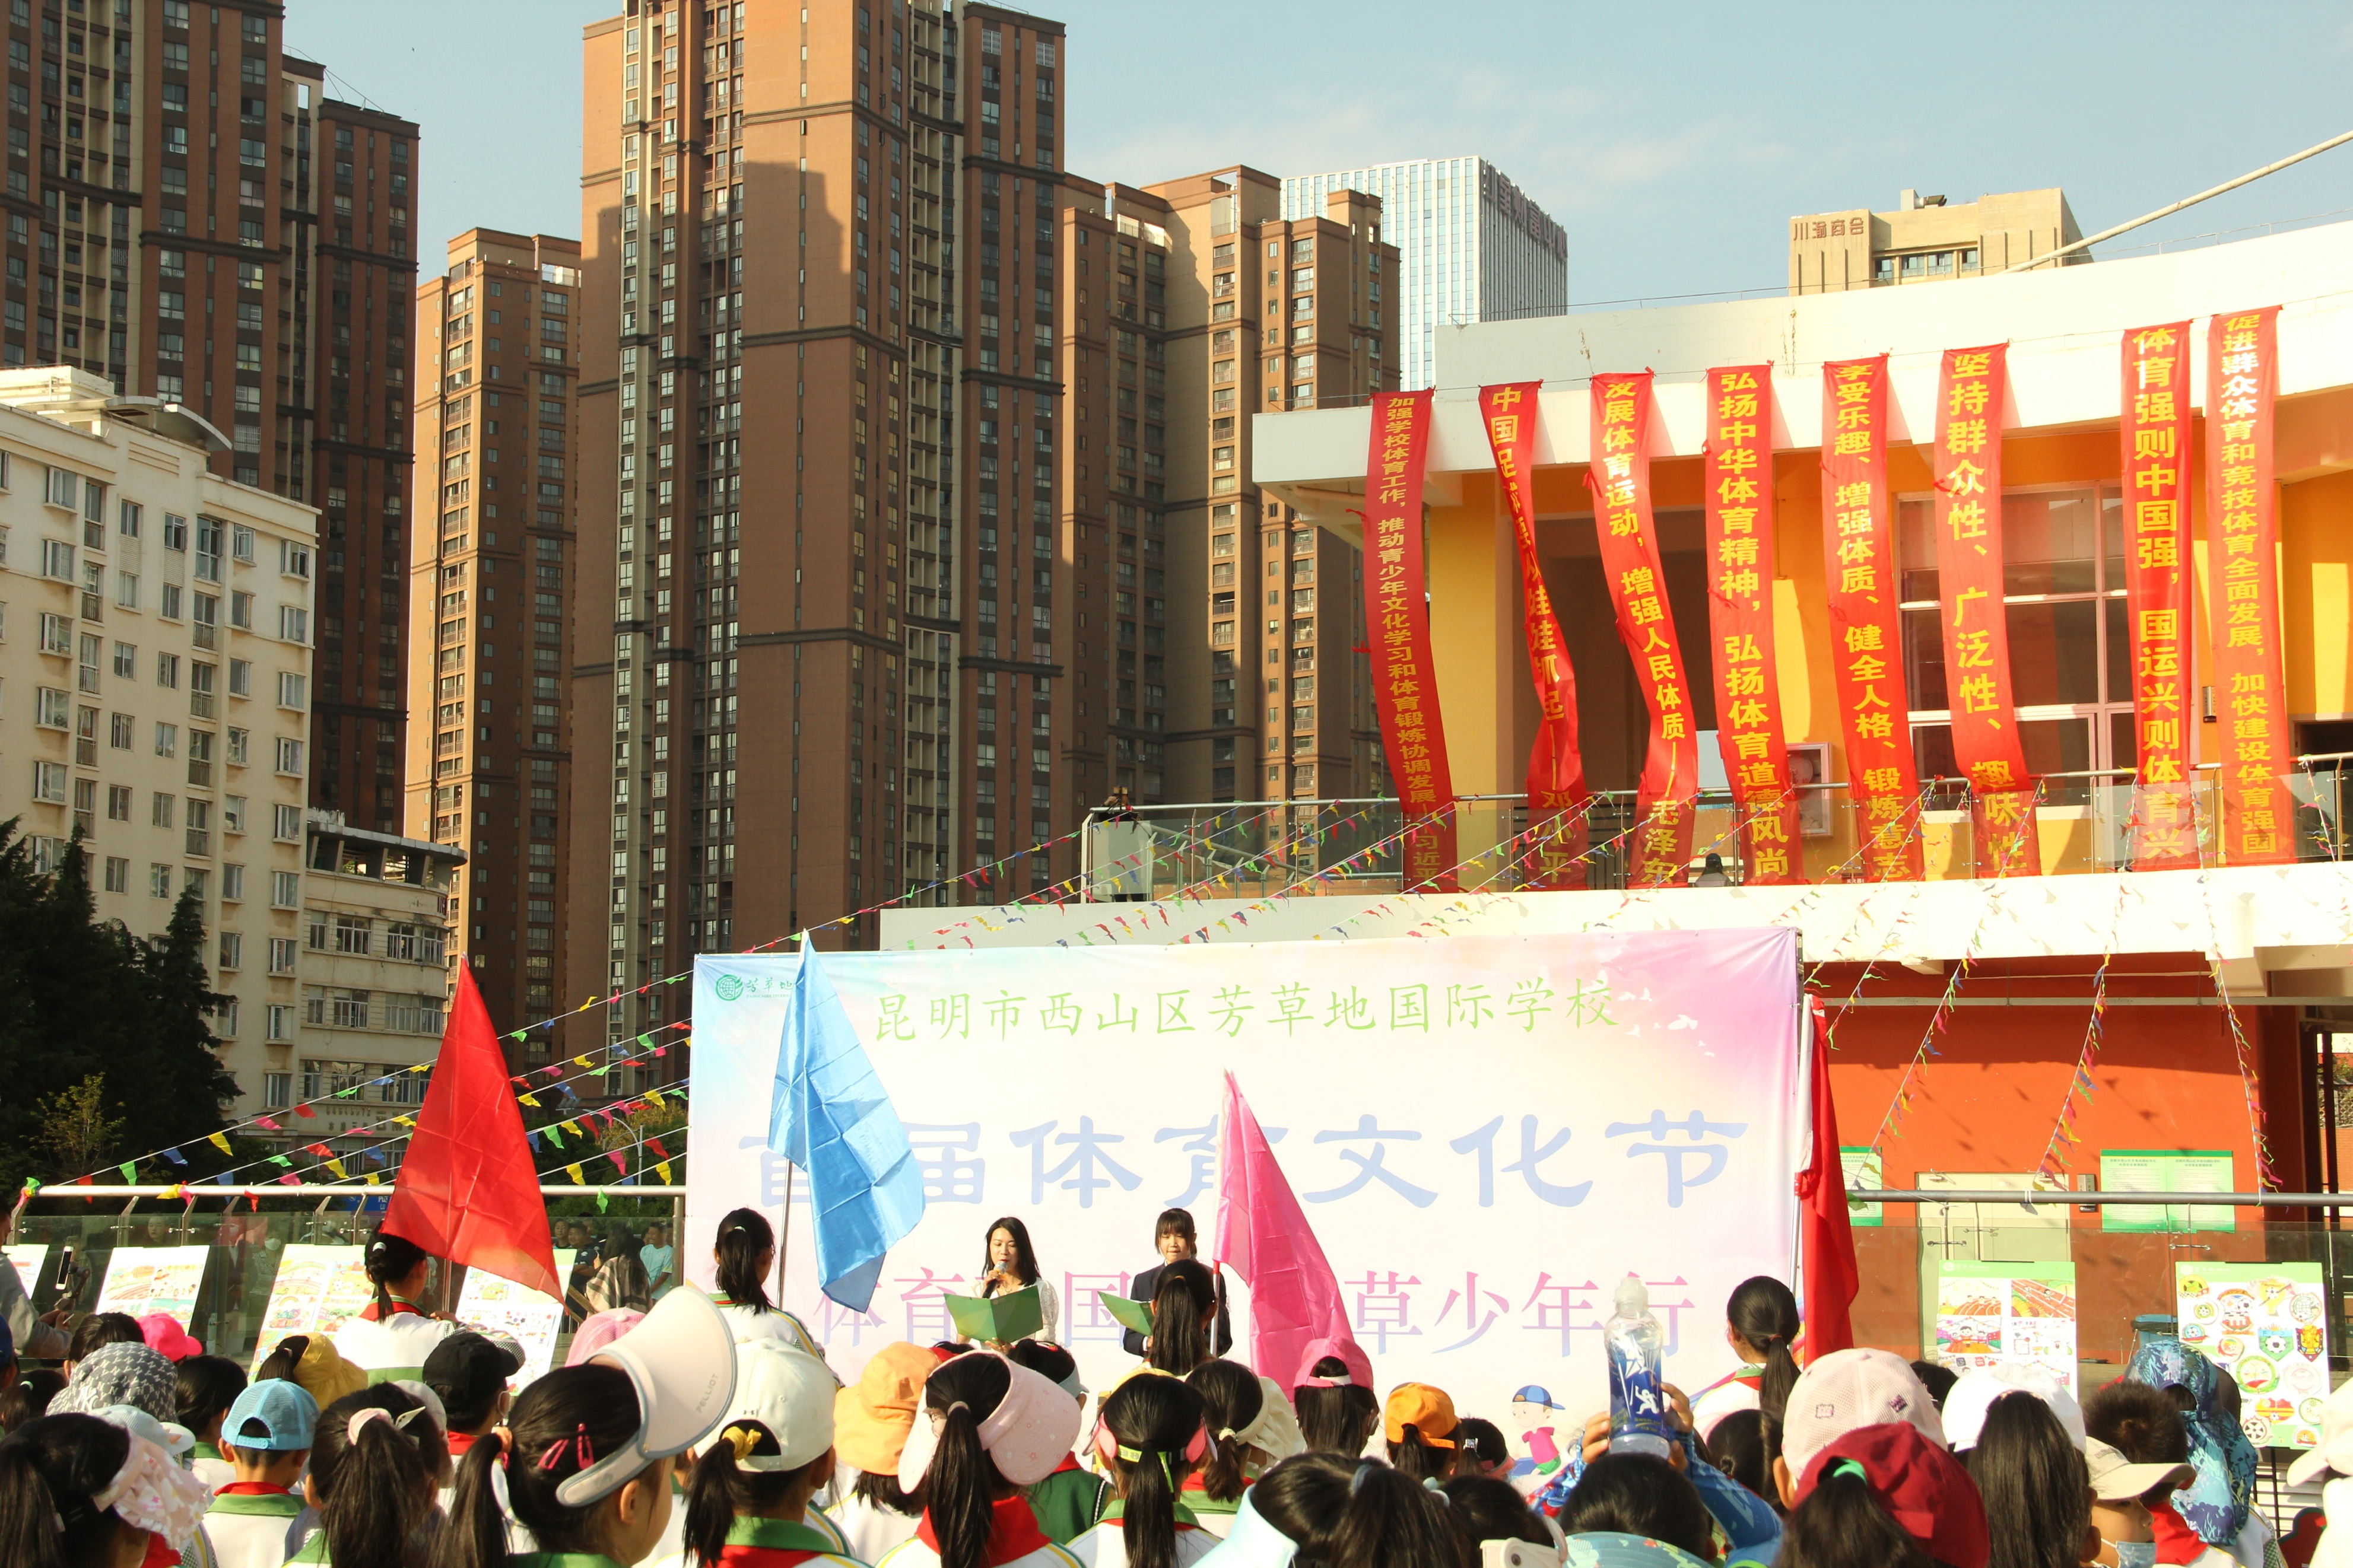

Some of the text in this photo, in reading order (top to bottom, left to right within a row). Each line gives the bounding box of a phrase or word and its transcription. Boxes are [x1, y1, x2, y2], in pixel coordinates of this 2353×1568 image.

[1793, 217, 1864, 241] 川渝商会
[875, 976, 1620, 1042] 昆明市西山区芳草地国际学校
